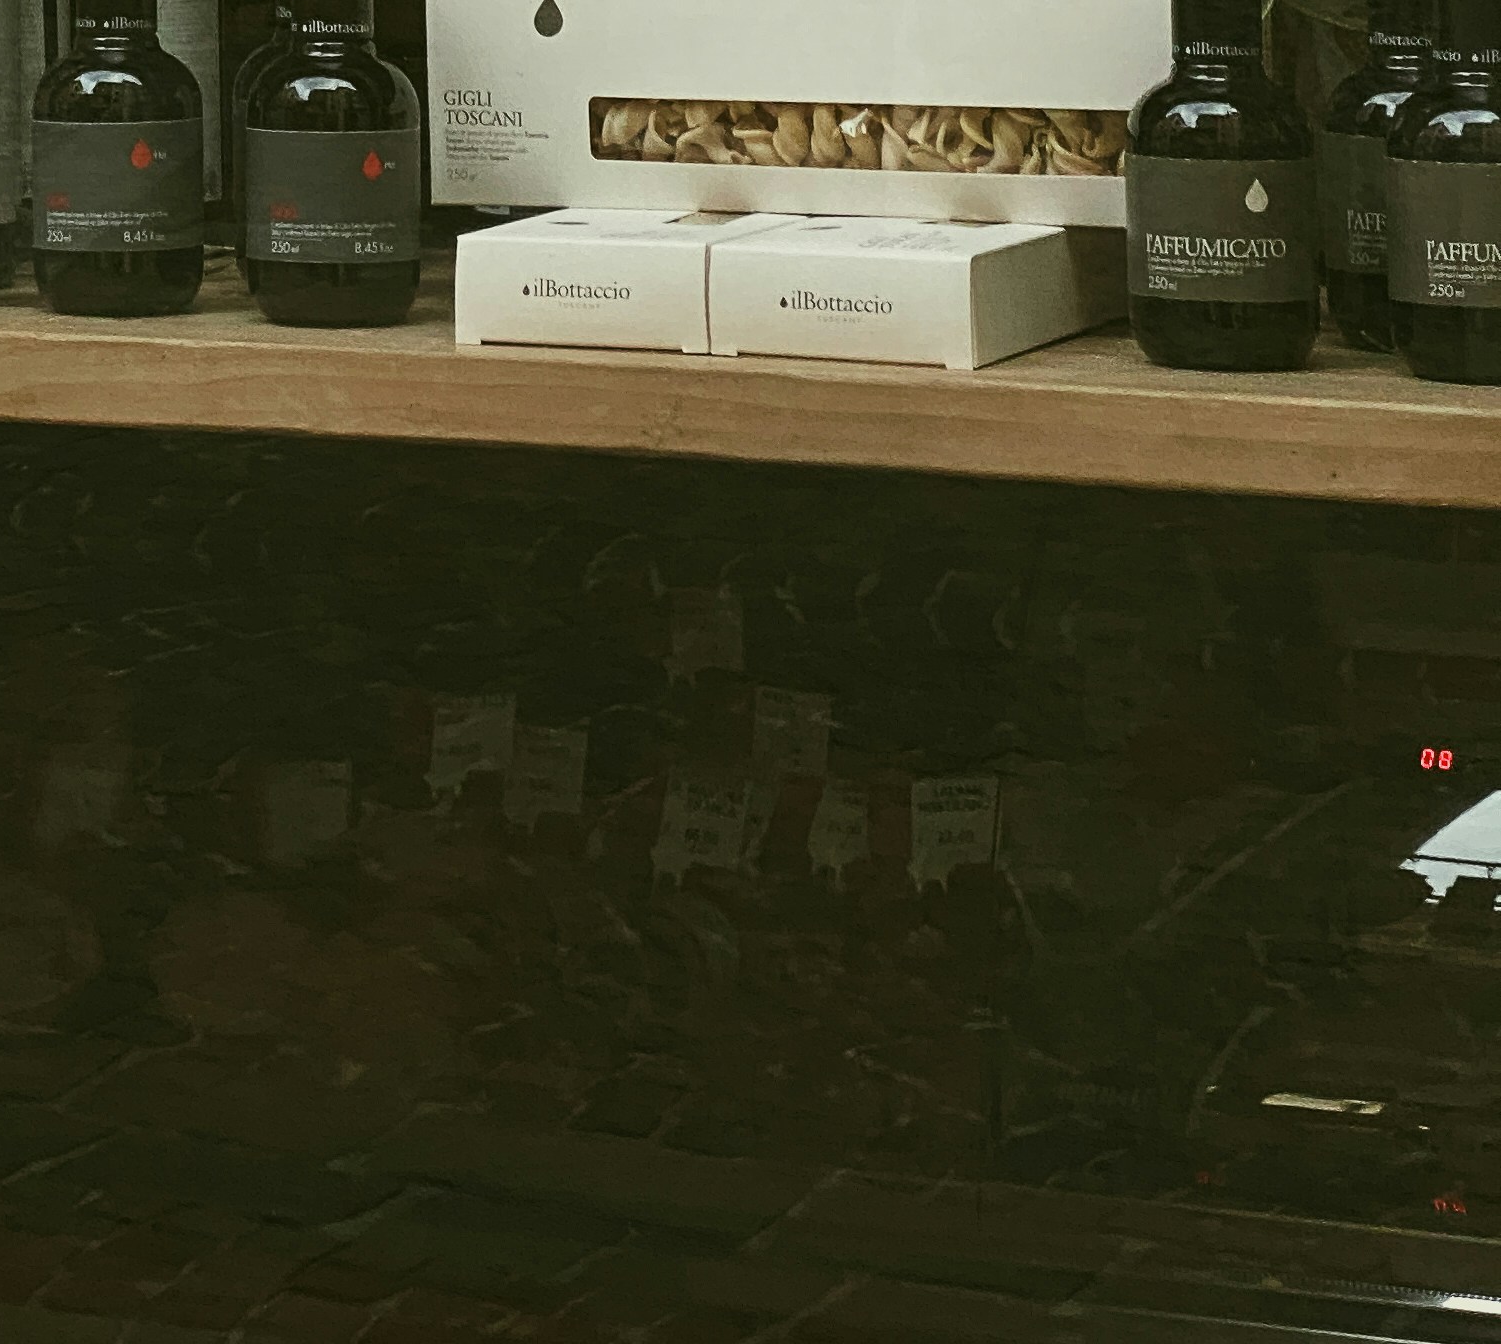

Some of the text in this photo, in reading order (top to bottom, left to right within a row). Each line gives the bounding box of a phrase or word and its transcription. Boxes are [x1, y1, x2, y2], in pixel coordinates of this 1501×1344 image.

[443, 89, 492, 108] GIGLI
[443, 108, 523, 127] TOSCANI
[533, 278, 631, 300] ilBottaccio
[790, 289, 893, 315] ilBottaccio
[1420, 748, 1453, 770] 08
